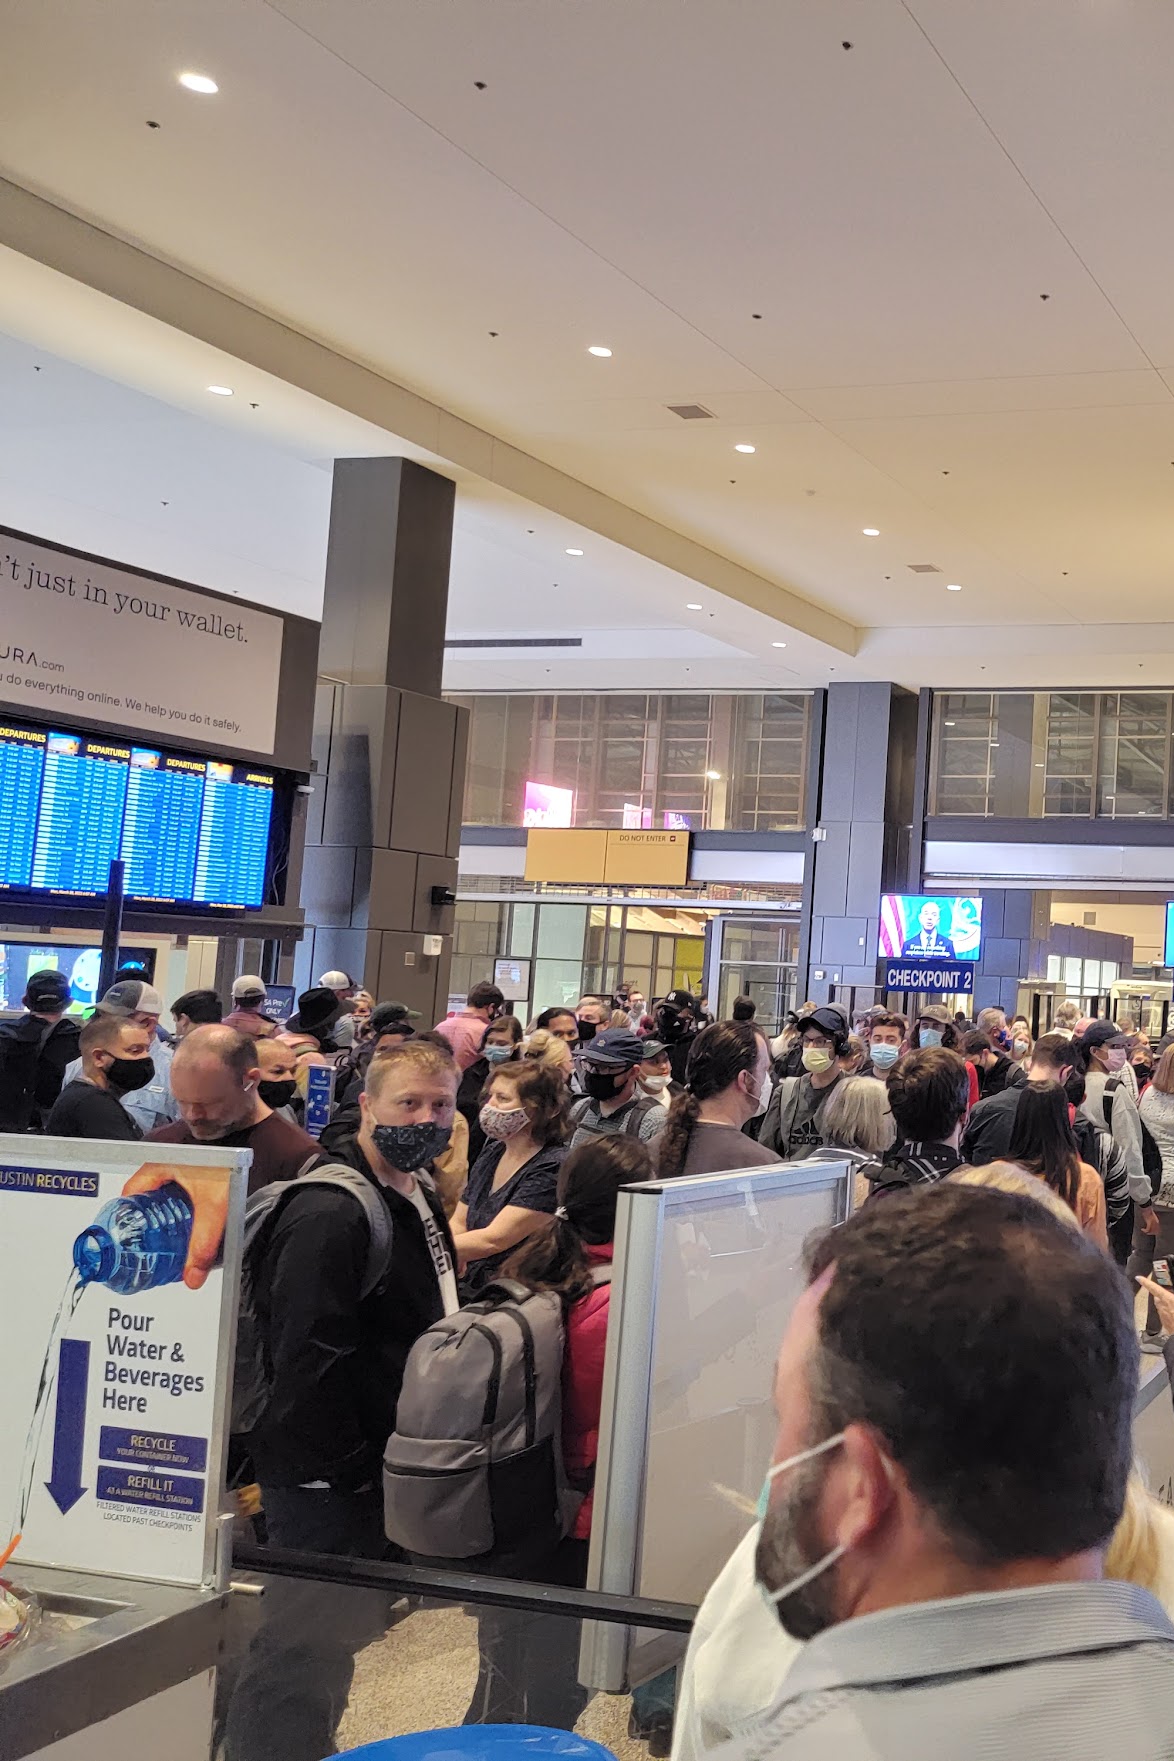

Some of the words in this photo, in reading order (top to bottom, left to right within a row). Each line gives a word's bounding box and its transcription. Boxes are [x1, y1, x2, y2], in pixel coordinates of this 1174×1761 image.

[0, 555, 20, 581] 't
[24, 562, 76, 597] just
[83, 579, 109, 605] in
[113, 591, 171, 621] your
[177, 608, 248, 643] wallet.
[7, 673, 22, 686] do
[25, 677, 85, 701] everything
[87, 693, 122, 708] online.
[125, 697, 142, 711] We
[144, 702, 167, 718] help
[168, 709, 188, 722] you
[190, 711, 202, 724] do
[204, 716, 211, 727] it
[213, 720, 242, 734] safely.
[0, 728, 46, 744] DEPARTURES
[87, 744, 131, 759] DEPARTURES
[167, 759, 206, 772] DEPARTURES
[246, 773, 273, 785] ARRIVALS
[619, 834, 629, 842] DO
[631, 834, 644, 842] NOT
[888, 969, 960, 988] CHECKPOINT
[963, 972, 971, 989] 2
[36, 1173, 97, 1192] RECYCLES
[108, 1307, 155, 1332] Pour
[106, 1334, 168, 1360] Water
[170, 1342, 185, 1363] &
[104, 1360, 205, 1397] Beverages
[102, 1387, 148, 1413] Here
[130, 1434, 177, 1452] RECYCLE
[117, 1447, 134, 1457] YOUR
[135, 1449, 172, 1460] CONTAINER
[116, 1487, 122, 1495] A
[122, 1488, 144, 1498] WATER
[128, 1474, 162, 1490] REFILL
[164, 1479, 174, 1492] IT
[96, 1501, 124, 1512] FILTERED
[126, 1504, 148, 1515] WATER
[149, 1508, 170, 1518] REFILL
[170, 1511, 202, 1523] STATIONS
[103, 1512, 131, 1523] LOCATED
[132, 1515, 149, 1525] PAST
[149, 1517, 193, 1532] CHECKPOINTS
